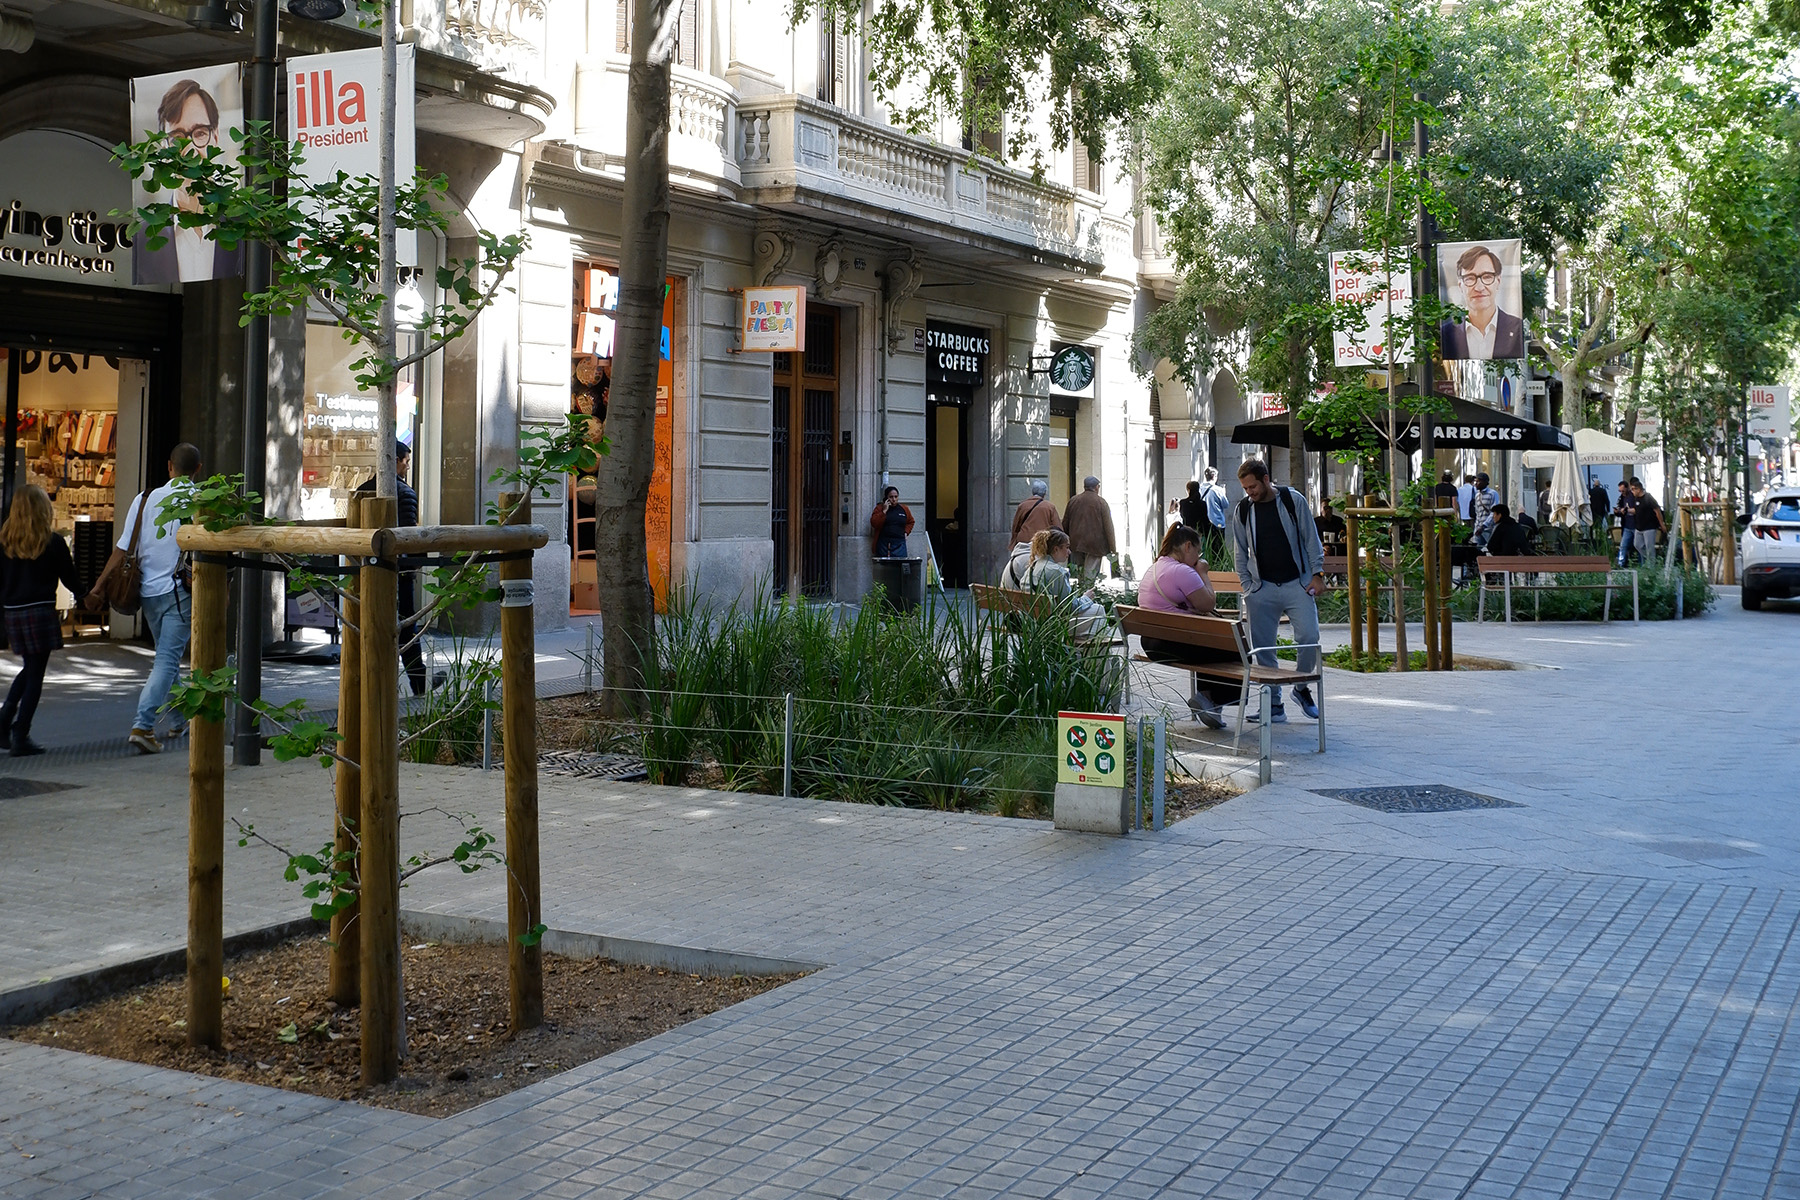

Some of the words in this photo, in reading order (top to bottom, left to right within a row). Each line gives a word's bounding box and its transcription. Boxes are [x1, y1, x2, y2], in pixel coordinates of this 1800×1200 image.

[295, 69, 367, 129] illa
[297, 127, 369, 148] President
[0, 245, 115, 275] copenhagen
[1335, 277, 1361, 293] per
[750, 300, 793, 316] PARTY
[747, 316, 794, 333] FIESTA
[927, 330, 990, 355] STARBUCKS
[939, 352, 978, 373] COFFEE
[1752, 390, 1775, 404] illa
[1410, 426, 1522, 440] SARBUCKS
